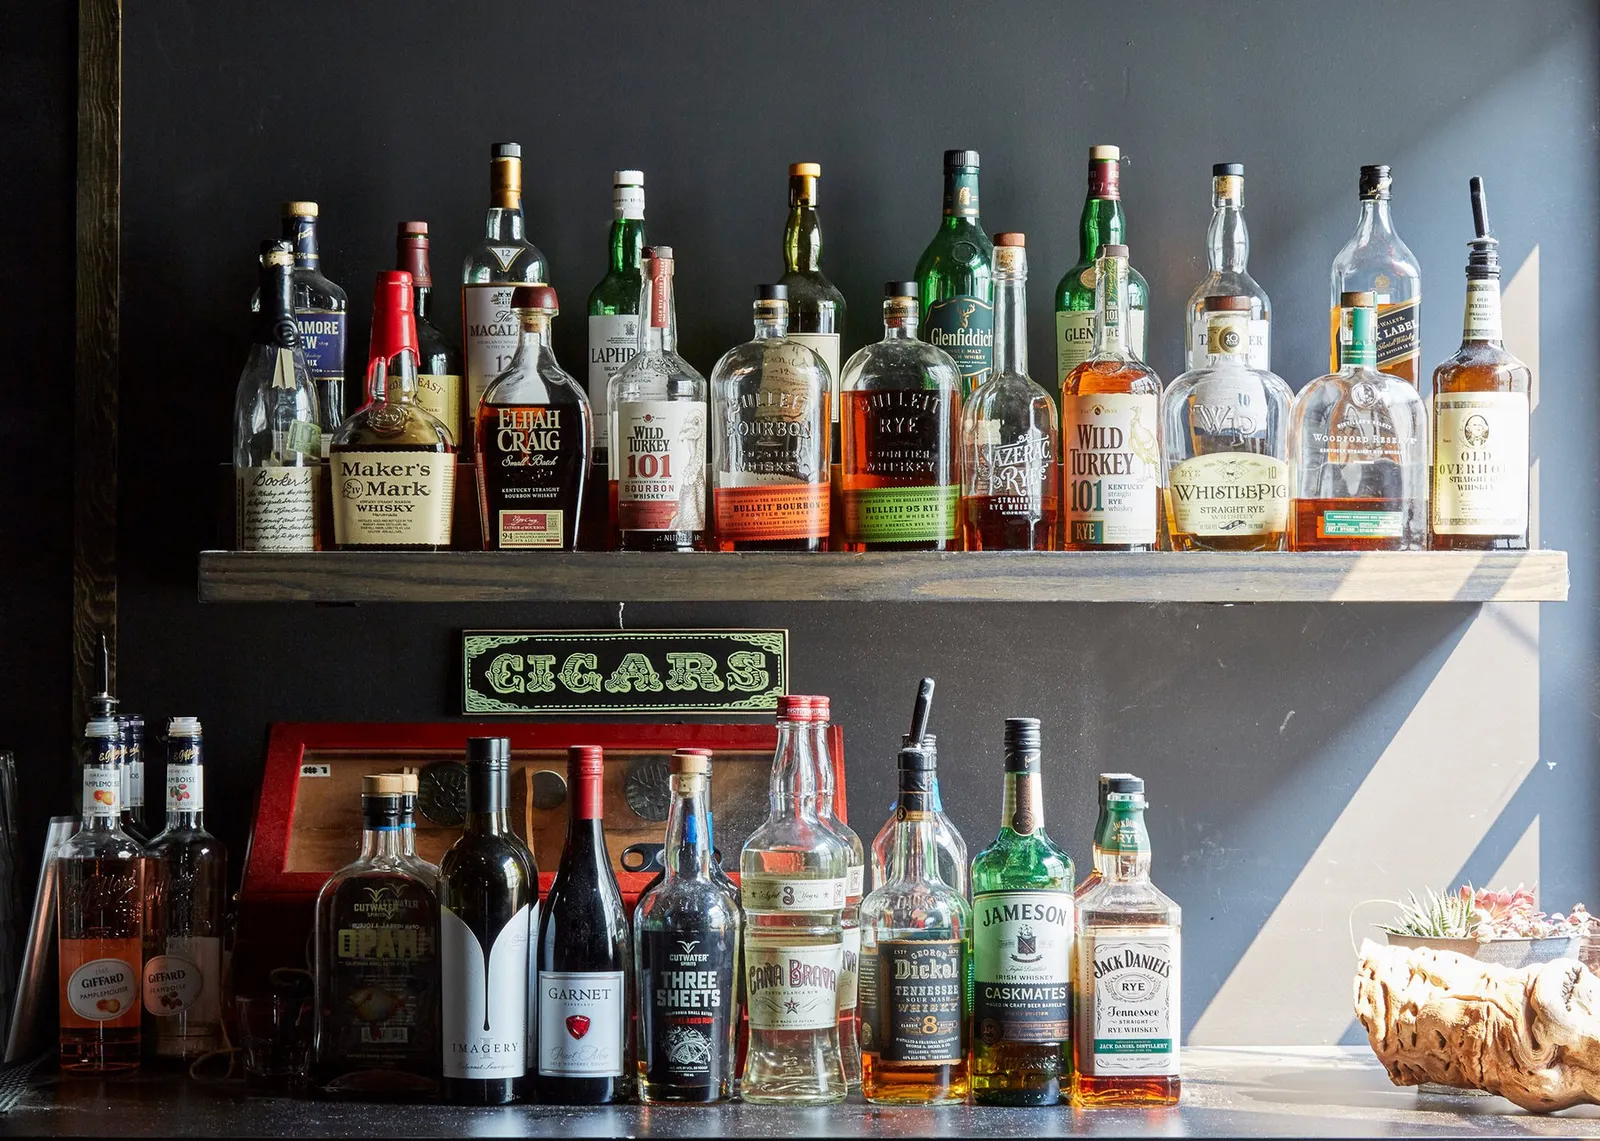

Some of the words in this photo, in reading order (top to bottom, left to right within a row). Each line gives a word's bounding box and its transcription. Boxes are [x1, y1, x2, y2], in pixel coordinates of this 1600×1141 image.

[501, 249, 511, 257] 12
[930, 327, 993, 347] Glenfiddich
[860, 391, 942, 414] BULLEIT
[497, 407, 561, 432] ELIJAH
[879, 416, 920, 434] RYE
[1372, 419, 1392, 431] SELECT
[633, 425, 663, 440] WILD
[1076, 424, 1123, 451] WILD
[1312, 432, 1370, 444] WOODFORD
[497, 430, 561, 454] CRAIG
[627, 436, 671, 453] TURKEY
[501, 454, 529, 468] Small
[528, 453, 559, 468] Batch
[1070, 448, 1135, 477] TURKEY
[1460, 451, 1493, 462] OLD
[341, 461, 431, 477] Maker's
[627, 454, 672, 479] 101
[253, 469, 313, 487] Booker's
[366, 480, 431, 497] Mark
[624, 484, 675, 493] BOURBON
[1071, 479, 1105, 513] 101
[356, 504, 416, 513] WHISKY
[733, 502, 773, 514] BULLEIT
[776, 501, 820, 511] BOURBON
[865, 505, 904, 514] BULLEIT
[905, 504, 920, 514] 95
[923, 504, 940, 513] RYE
[1200, 505, 1244, 514] STRAIGHT
[1246, 505, 1266, 514] RYE
[1076, 522, 1096, 541] RYE
[484, 650, 770, 694] CIGARS
[982, 903, 1068, 928] JAMESON
[669, 953, 710, 963] CUTWATER
[910, 948, 952, 961] GEORGE
[894, 957, 959, 981] Dickel
[1092, 953, 1128, 979] JACK
[1124, 949, 1173, 979] DANIEL'S
[81, 973, 124, 989] GIFFARD
[148, 970, 186, 984] GIFFARD
[661, 970, 717, 989] THREE
[79, 985, 129, 1000] PAMPLEMOUSSE
[548, 987, 612, 1003] GARNET
[894, 985, 960, 997] TENNESSEE
[984, 986, 1067, 1001] CASKMATES
[1121, 982, 1146, 992] RYE
[656, 988, 721, 1008] SHEETS
[897, 1002, 959, 1014] WHISKY
[1107, 1005, 1160, 1018] Tennessee
[921, 1014, 938, 1035] 8
[451, 1042, 518, 1054] IMAGERY
